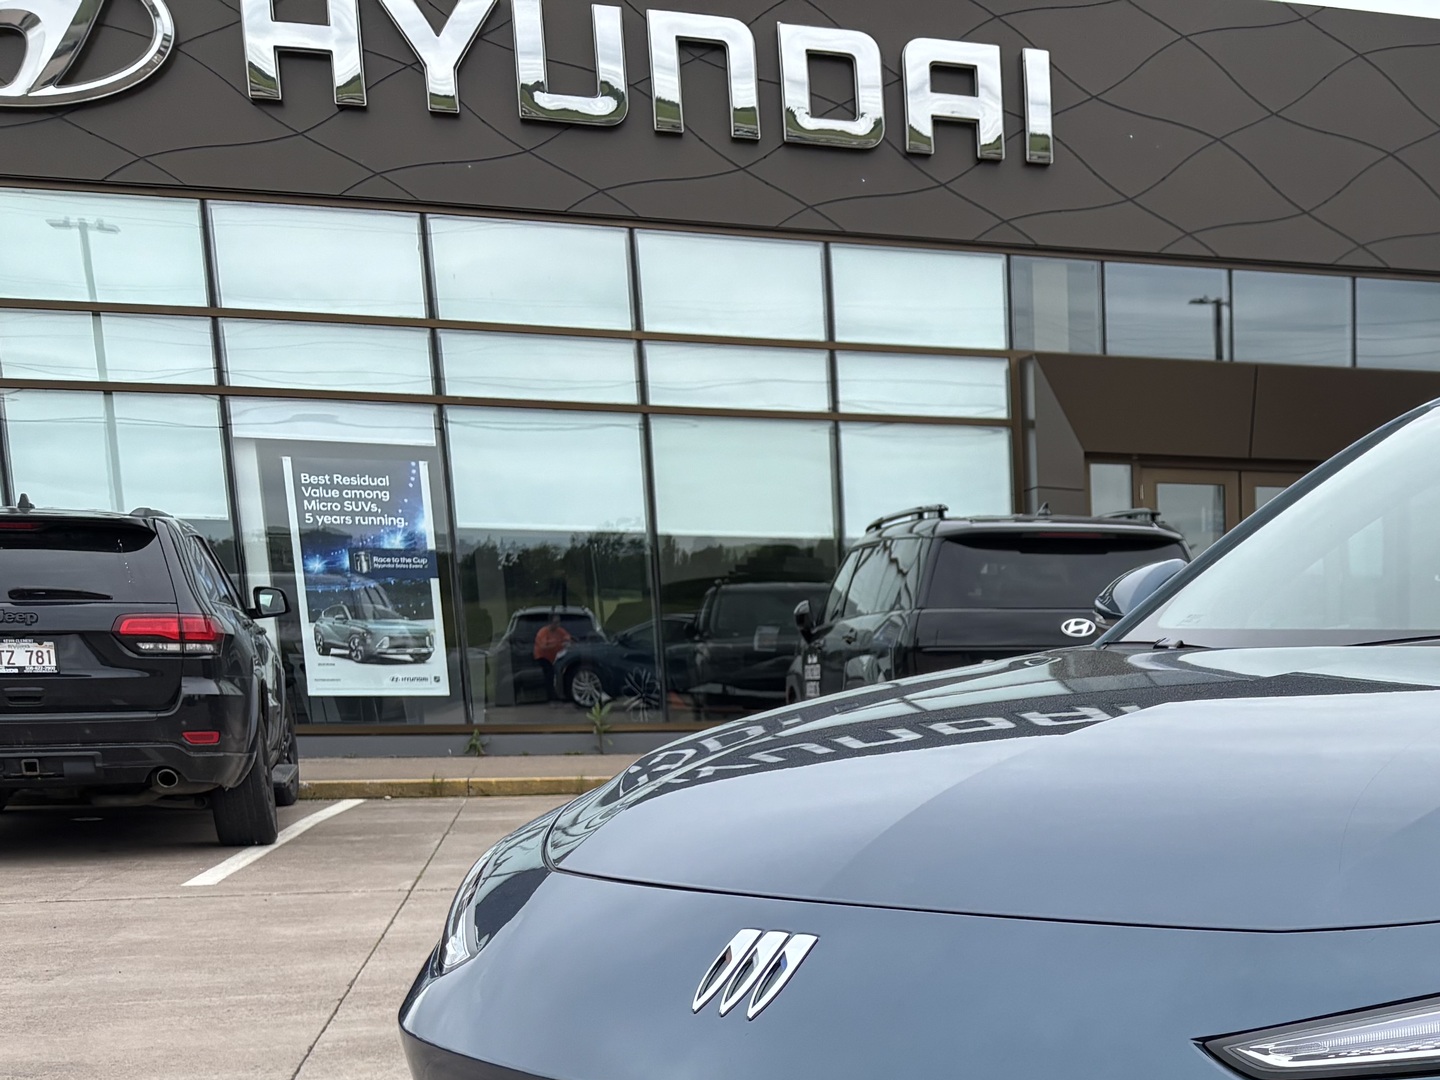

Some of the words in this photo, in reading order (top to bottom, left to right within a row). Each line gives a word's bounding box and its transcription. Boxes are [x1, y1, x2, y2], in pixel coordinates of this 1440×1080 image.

[240, 0, 1054, 164] HYUNDAI
[300, 473, 331, 485] Best
[333, 474, 390, 486] Residual
[301, 486, 340, 498] Value
[342, 489, 390, 502] among
[303, 499, 341, 511] Micro
[343, 500, 382, 513] SUVs,
[305, 512, 313, 524] 5
[316, 514, 353, 526] years
[355, 514, 409, 528] running.
[373, 556, 391, 564] Race
[412, 556, 428, 565] Cup
[25, 649, 52, 666] 781
